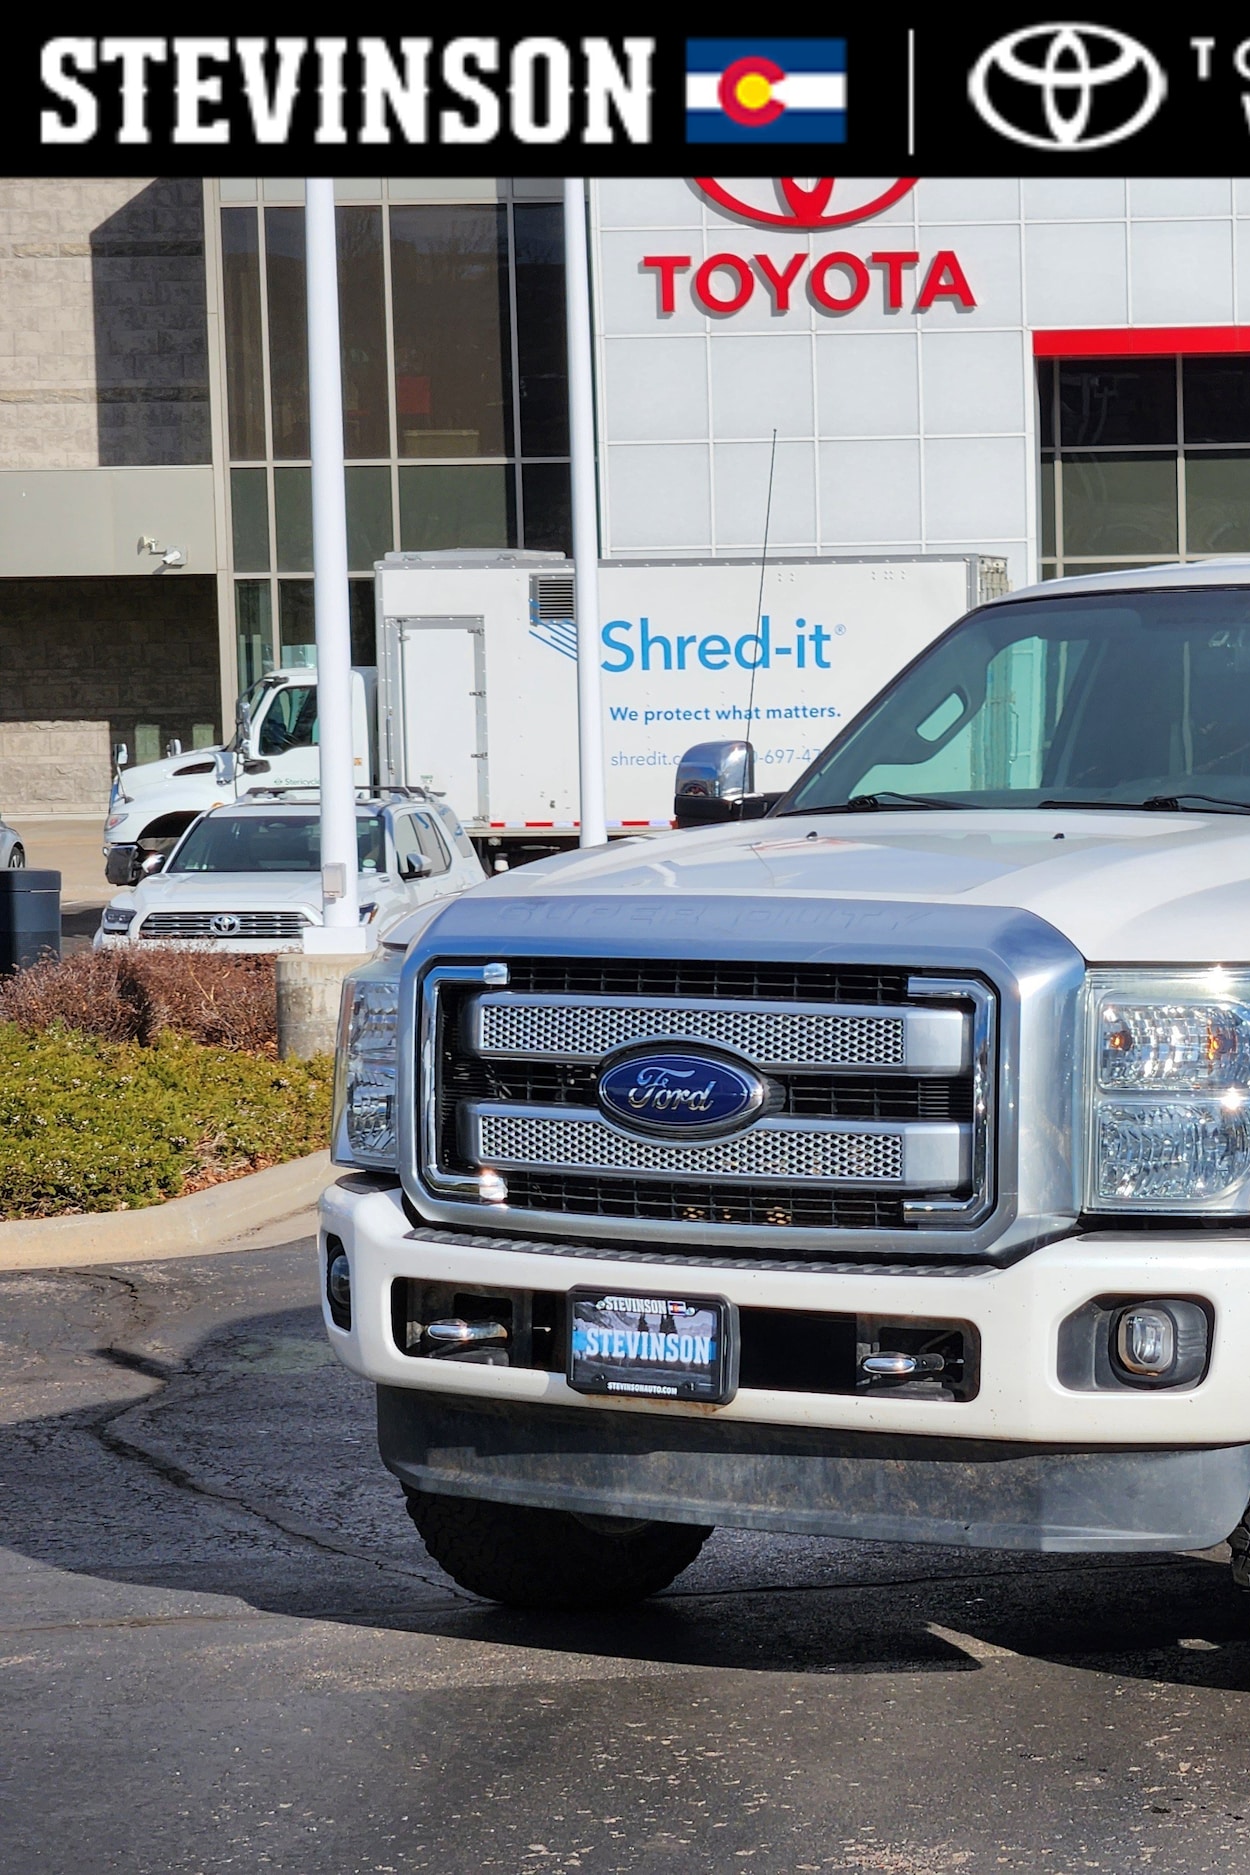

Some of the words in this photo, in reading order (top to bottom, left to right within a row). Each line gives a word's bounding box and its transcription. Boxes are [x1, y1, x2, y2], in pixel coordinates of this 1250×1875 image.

[643, 250, 977, 313] TOYOTA
[610, 706, 638, 721] We
[644, 707, 711, 725] protect
[715, 705, 761, 721] what
[766, 705, 842, 720] matters.
[611, 751, 681, 766] shredit.c
[628, 1066, 717, 1111] Ford
[605, 1296, 668, 1315] STEVINSON
[585, 1328, 711, 1365] STEVINSON
